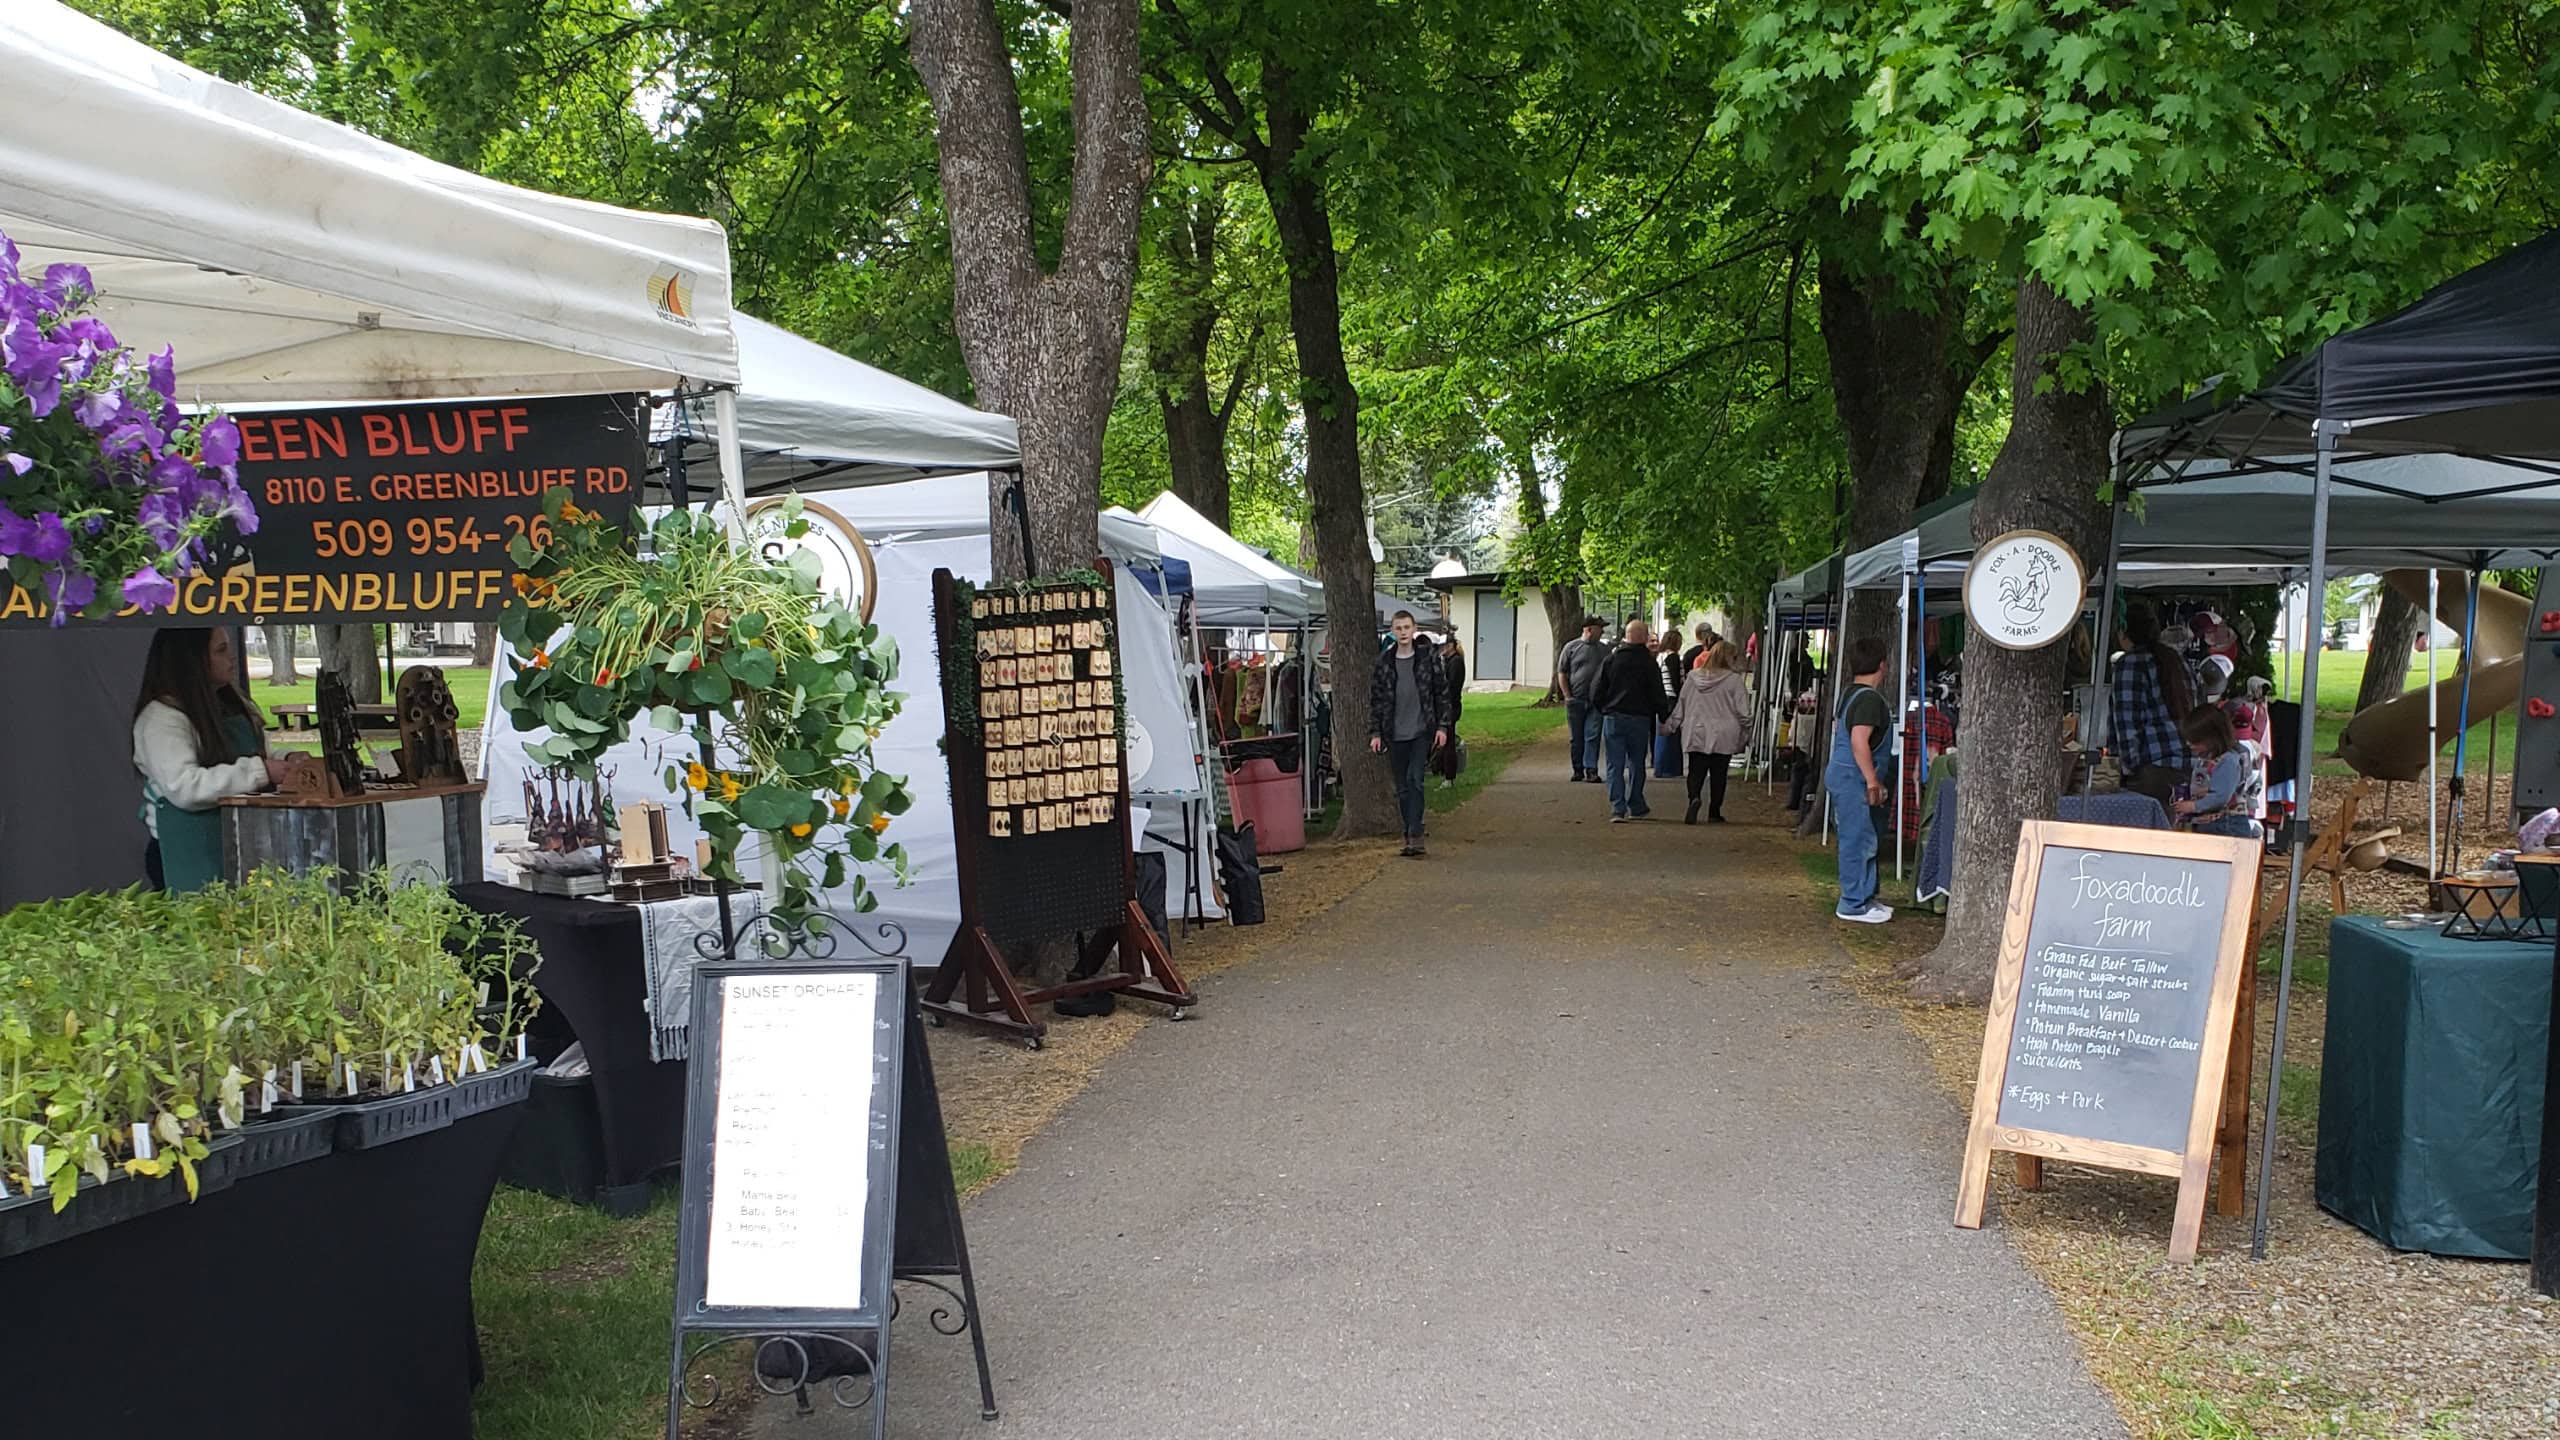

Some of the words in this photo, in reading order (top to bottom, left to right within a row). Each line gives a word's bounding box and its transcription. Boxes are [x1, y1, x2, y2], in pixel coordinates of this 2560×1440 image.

[238, 415, 348, 461] EEN
[361, 407, 529, 457] BLUFF
[265, 477, 326, 505] 8110
[335, 476, 362, 502] E.
[370, 468, 576, 501] GREENBLUFF
[586, 467, 633, 494] RD.
[312, 517, 394, 558] 509
[406, 513, 554, 556] 954-26
[1989, 554, 2006, 574] FOX
[2012, 546, 2020, 555] A
[2028, 544, 2061, 573] DOODLE
[2004, 625, 2038, 637] FARMS
[2070, 853, 2206, 909] foxadoodle
[2093, 903, 2152, 947] farm
[2043, 946, 2076, 965] Grass
[2078, 953, 2096, 969] Fed
[2101, 955, 2127, 970] Beef
[2131, 958, 2169, 974] Tallow
[2042, 964, 2085, 985] Organic
[732, 985, 789, 999] SUNSET
[2099, 1004, 2140, 1023] Vanilla
[2025, 1035, 2048, 1055] High
[2067, 1022, 2117, 1041] Breakfast
[2127, 1028, 2167, 1048] Dessert
[2072, 1091, 2105, 1111] Pork
